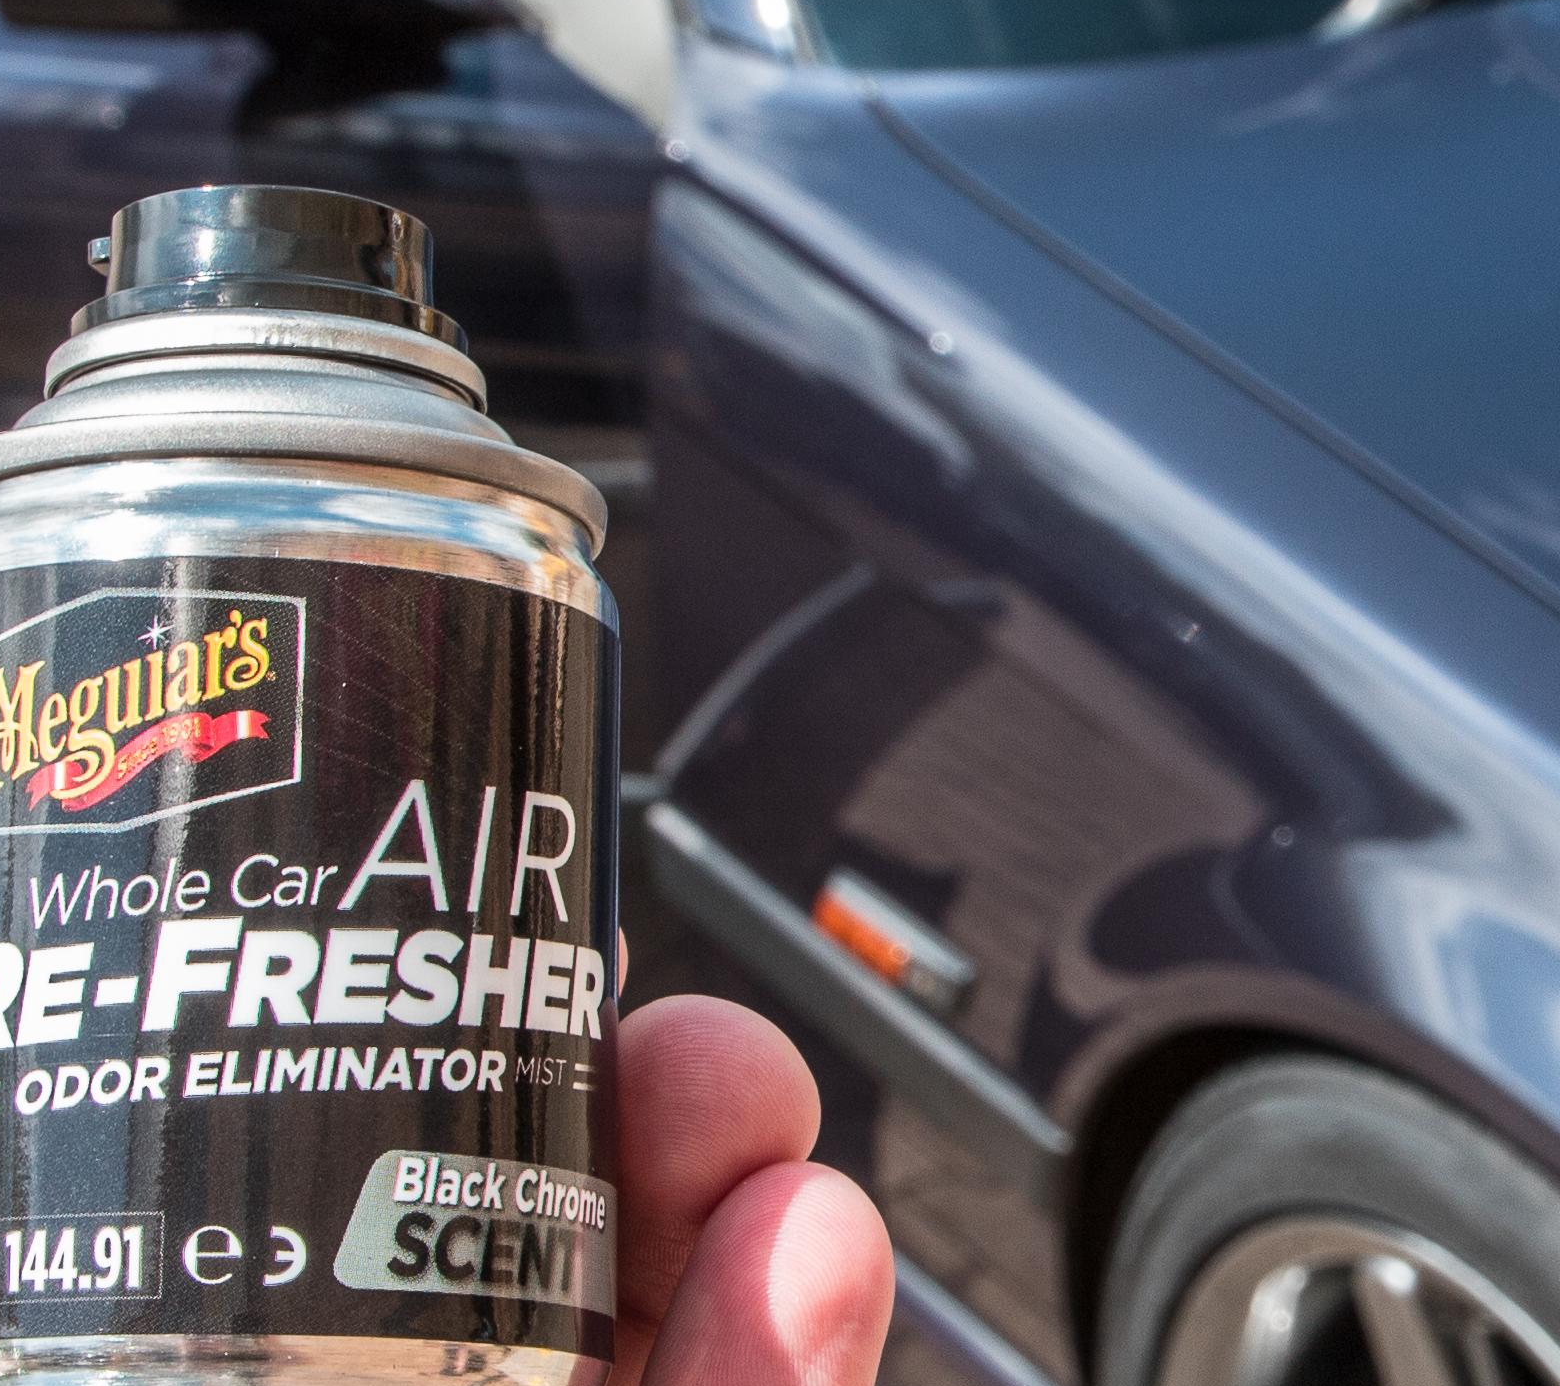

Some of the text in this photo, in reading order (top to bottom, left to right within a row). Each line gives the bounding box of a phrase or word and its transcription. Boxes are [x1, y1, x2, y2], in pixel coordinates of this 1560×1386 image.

[29, 778, 577, 931] Whole Car AIR
[13, 1046, 567, 1116] ODOR ELIMINATOR MIST
[393, 1156, 606, 1230] Black Chrome
[4, 1224, 144, 1294] 144.91
[387, 1210, 583, 1293] SCENT
